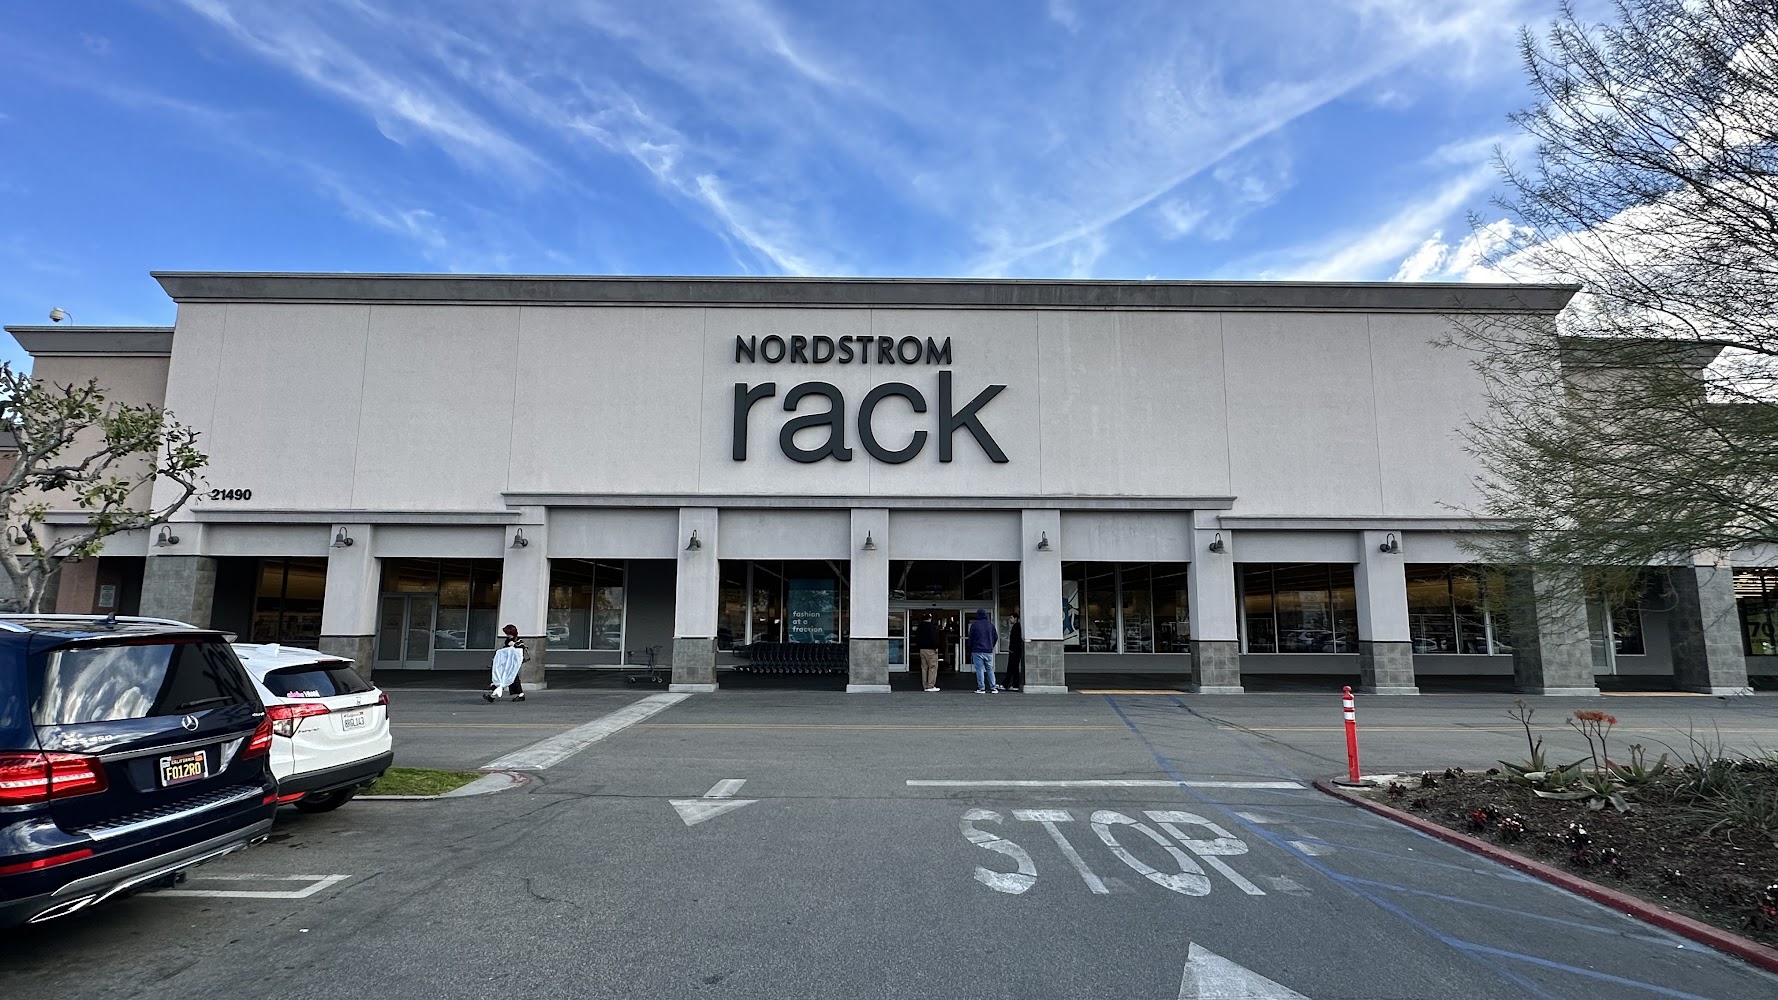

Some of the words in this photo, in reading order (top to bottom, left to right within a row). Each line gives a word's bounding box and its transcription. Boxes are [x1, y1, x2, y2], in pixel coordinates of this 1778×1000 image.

[735, 334, 952, 365] NORDSTROM
[732, 370, 1010, 465] rack
[211, 488, 252, 501] 21490
[792, 610, 821, 618] fashion
[792, 625, 823, 633] fraction
[171, 756, 195, 765] CALIFORNIA
[958, 808, 1266, 897] STOP
